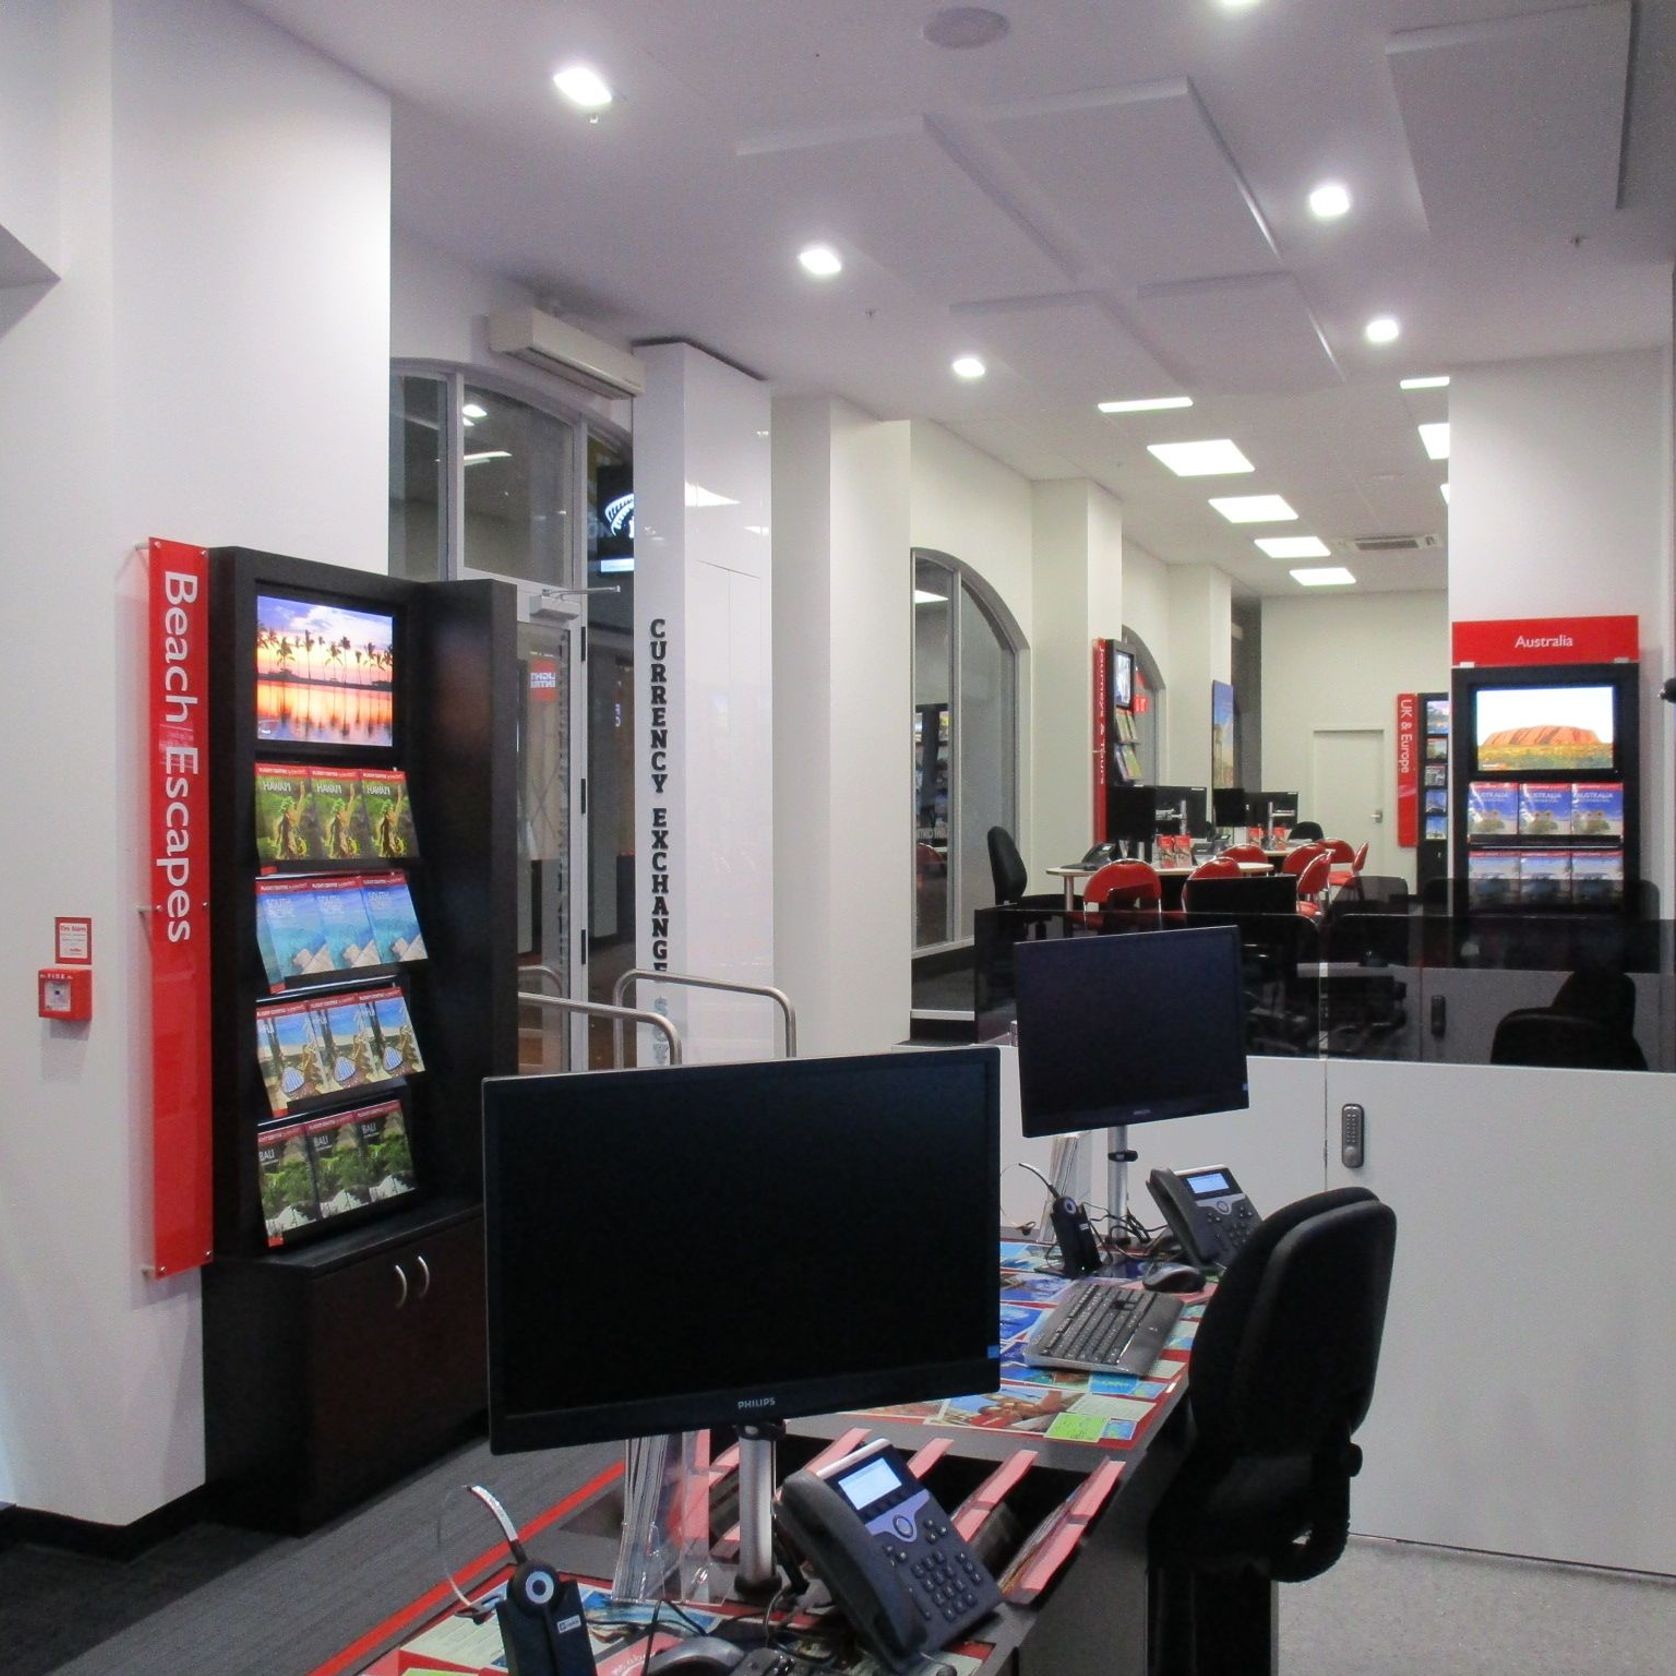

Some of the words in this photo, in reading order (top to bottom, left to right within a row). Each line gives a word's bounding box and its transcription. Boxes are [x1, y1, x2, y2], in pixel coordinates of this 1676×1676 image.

[165, 570, 198, 723] Beach
[1515, 634, 1574, 649] Australia
[650, 618, 669, 794] CURRENCY
[1400, 698, 1413, 719] UK
[1401, 721, 1413, 731] &
[1398, 733, 1413, 774] Europe
[157, 746, 199, 943] Escapes
[737, 1397, 776, 1410] PHILIPS
